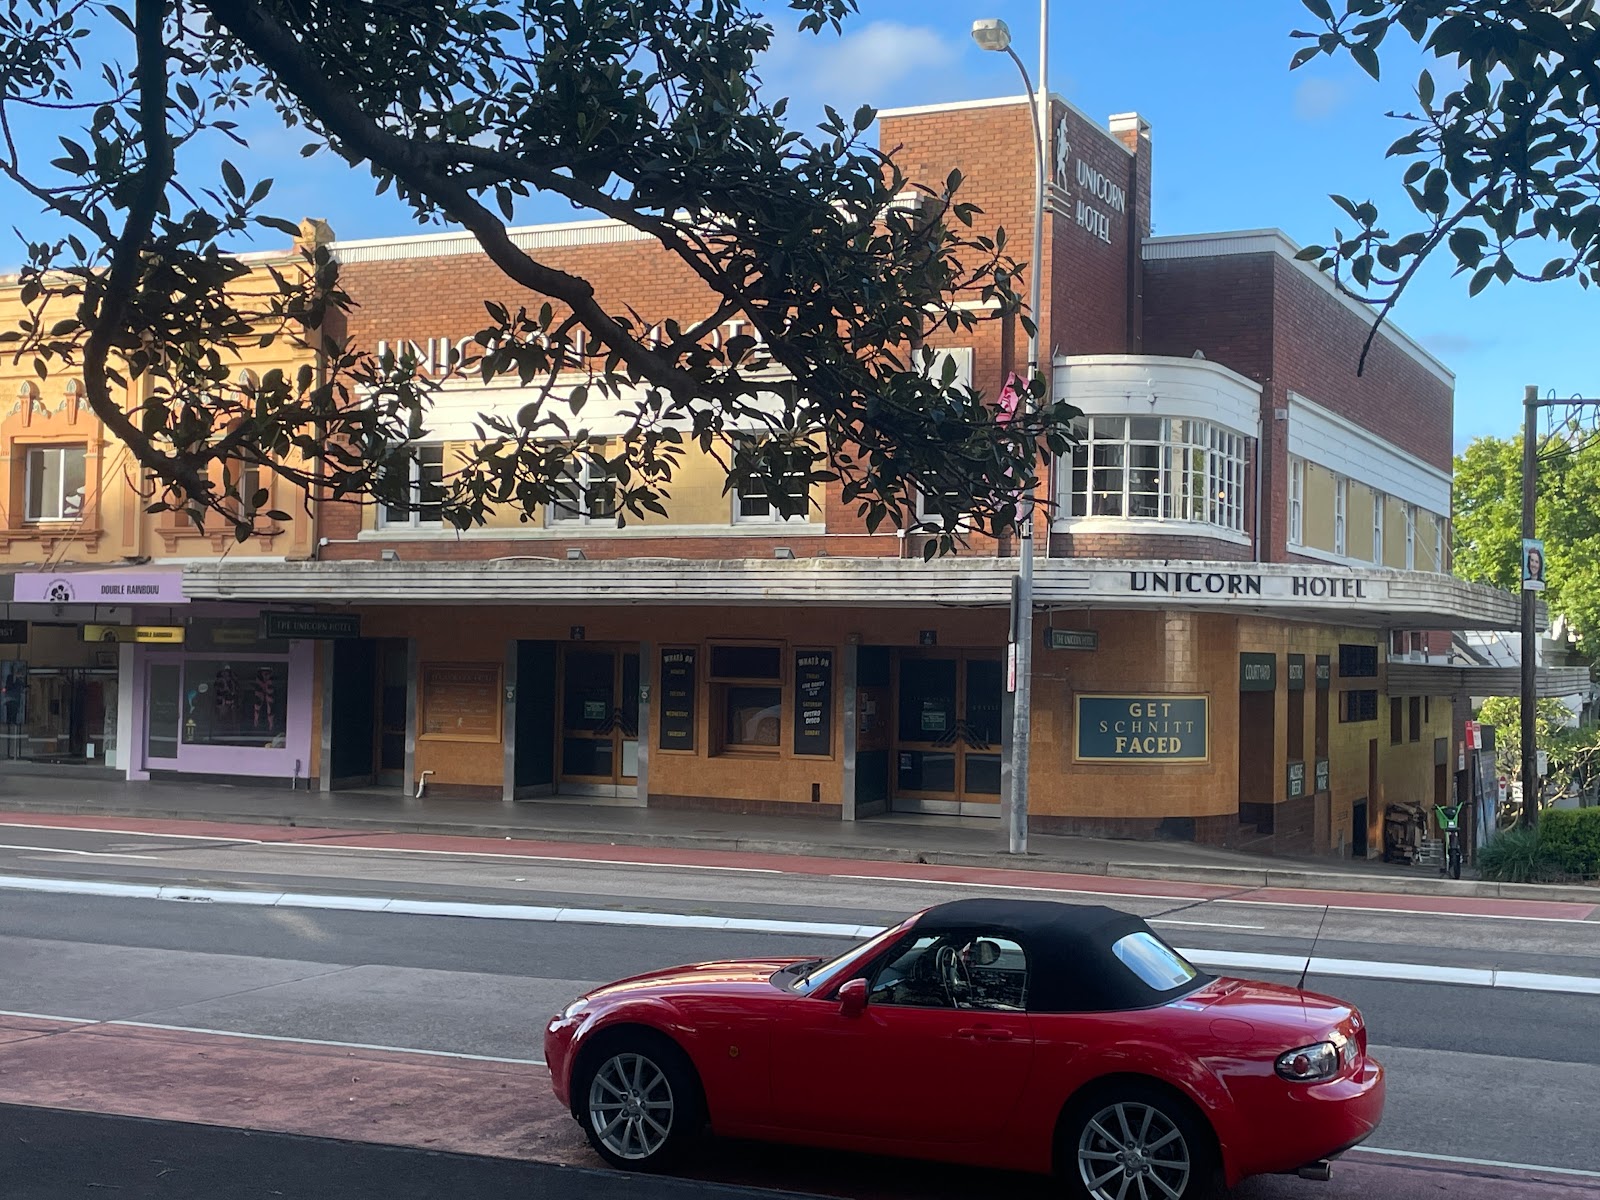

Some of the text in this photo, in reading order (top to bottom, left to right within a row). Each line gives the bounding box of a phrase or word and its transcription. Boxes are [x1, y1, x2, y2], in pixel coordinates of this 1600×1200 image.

[1076, 158, 1126, 215] UNICORN
[1076, 200, 1112, 245] HOTEL
[101, 585, 125, 595] DOUBLE
[1129, 570, 1367, 599] UNICORN HOTEL
[820, 657, 830, 667] ON
[1129, 702, 1171, 718] GET
[1099, 720, 1194, 734] SCHNITT
[1115, 737, 1182, 754] FACED
